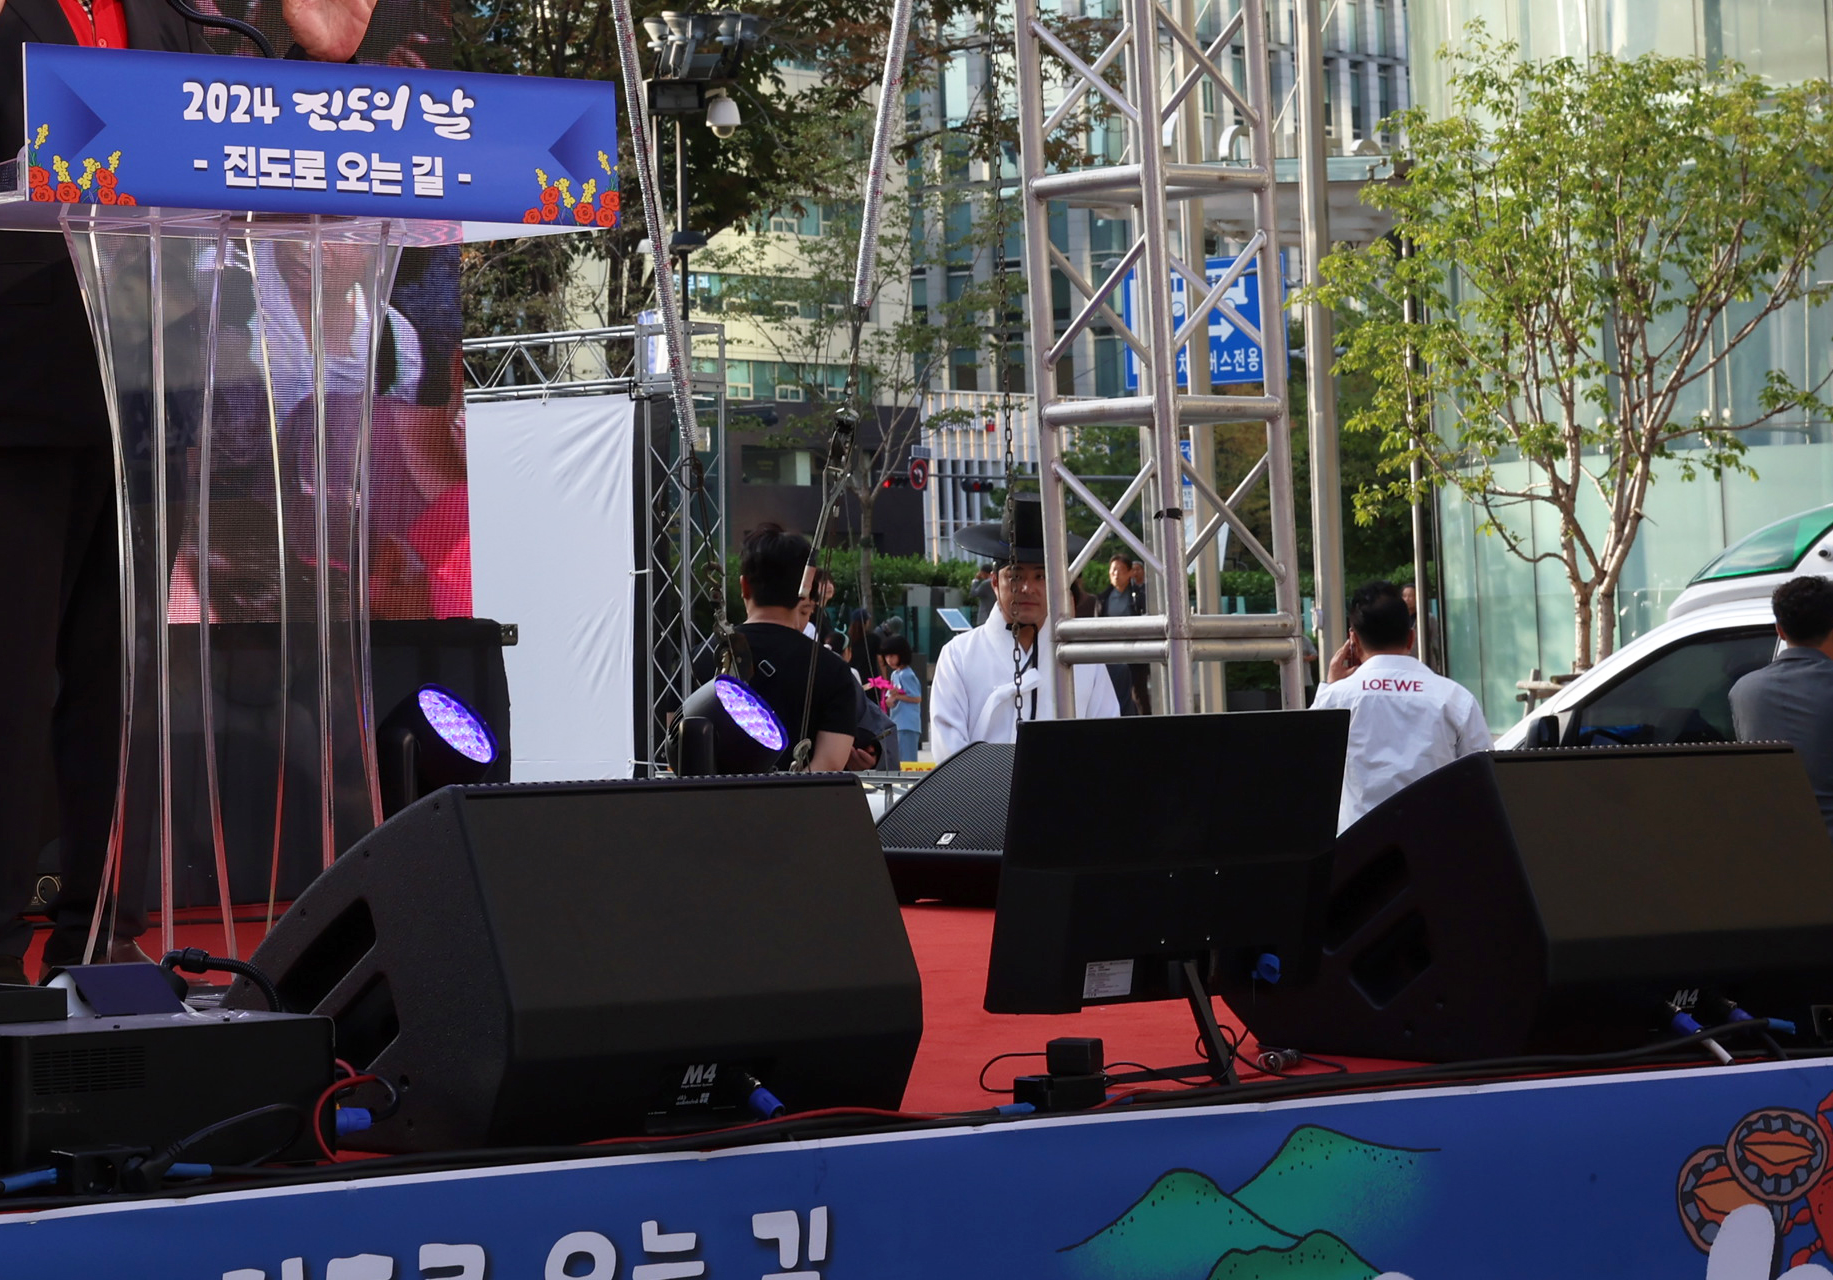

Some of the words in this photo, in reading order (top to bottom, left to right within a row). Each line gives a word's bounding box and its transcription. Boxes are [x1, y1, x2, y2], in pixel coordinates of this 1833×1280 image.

[182, 81, 280, 124] 2024
[291, 84, 410, 132] 진도의
[419, 88, 475, 140] 날
[223, 145, 327, 189] 진도로
[336, 151, 403, 195] 오는
[412, 155, 444, 197] 길
[1362, 678, 1424, 692] LOEWE
[1673, 989, 1699, 1006] M4
[682, 1063, 717, 1084] M4
